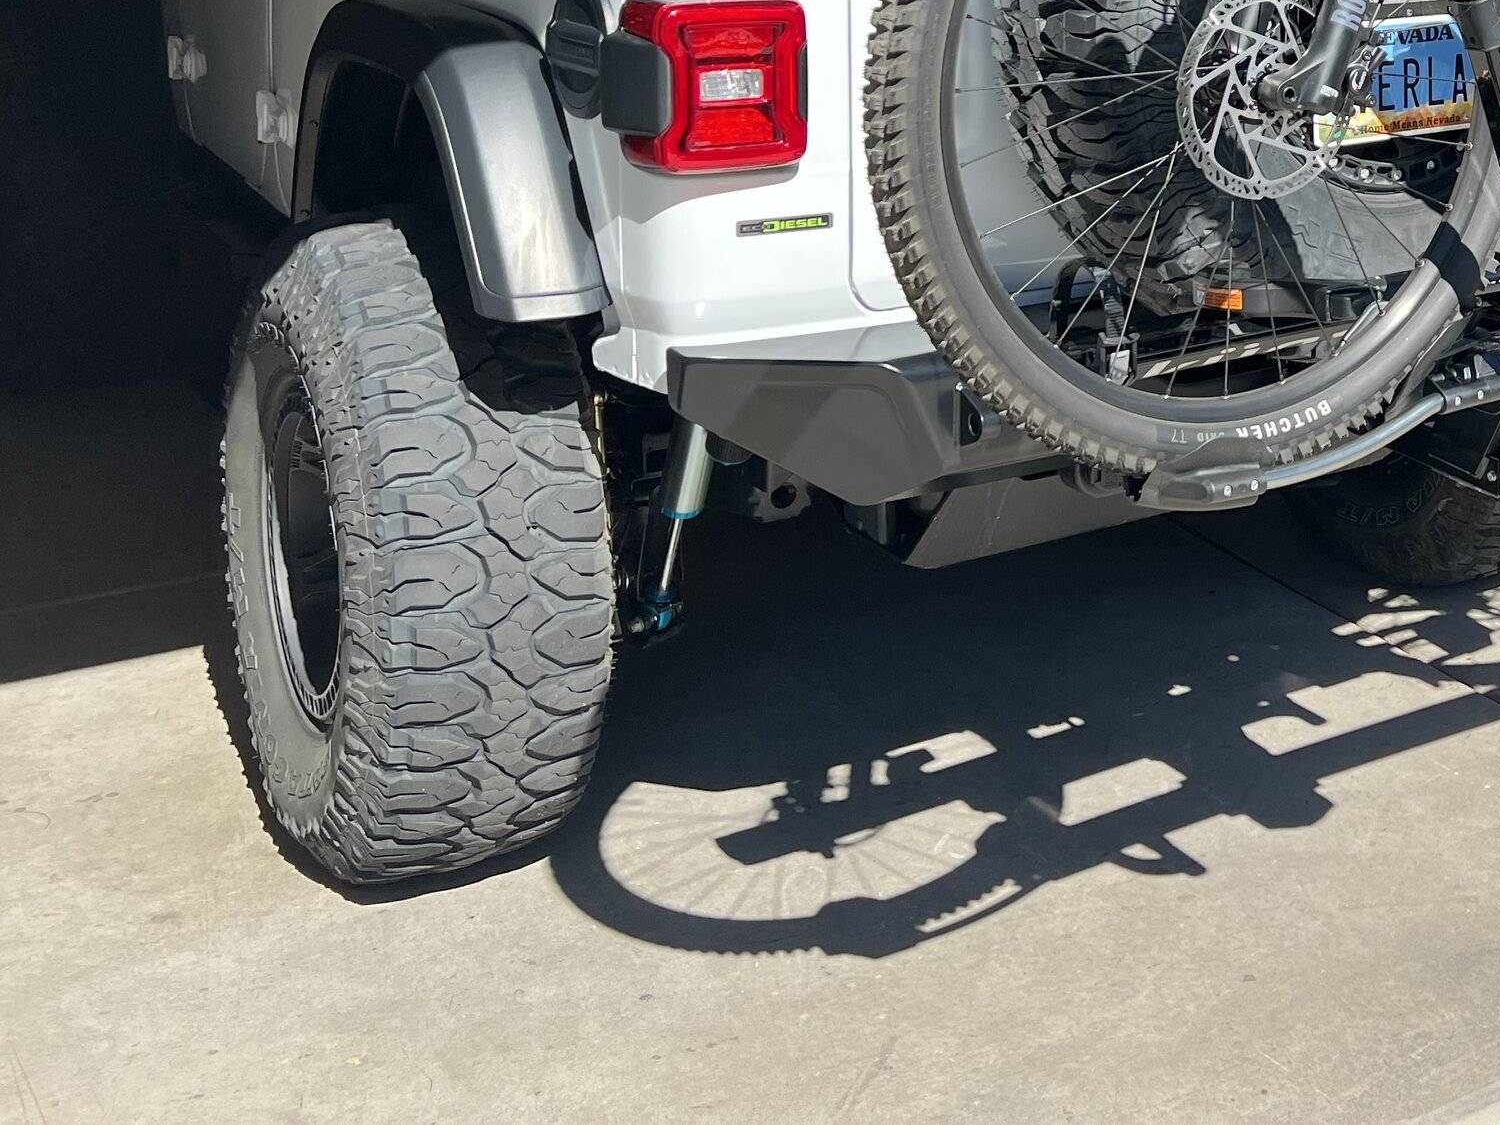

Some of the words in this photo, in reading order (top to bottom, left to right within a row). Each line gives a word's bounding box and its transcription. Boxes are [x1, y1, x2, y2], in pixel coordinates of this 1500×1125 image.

[1378, 25, 1455, 46] EVADA
[1392, 119, 1424, 132] Means
[1426, 114, 1461, 126] Nevada
